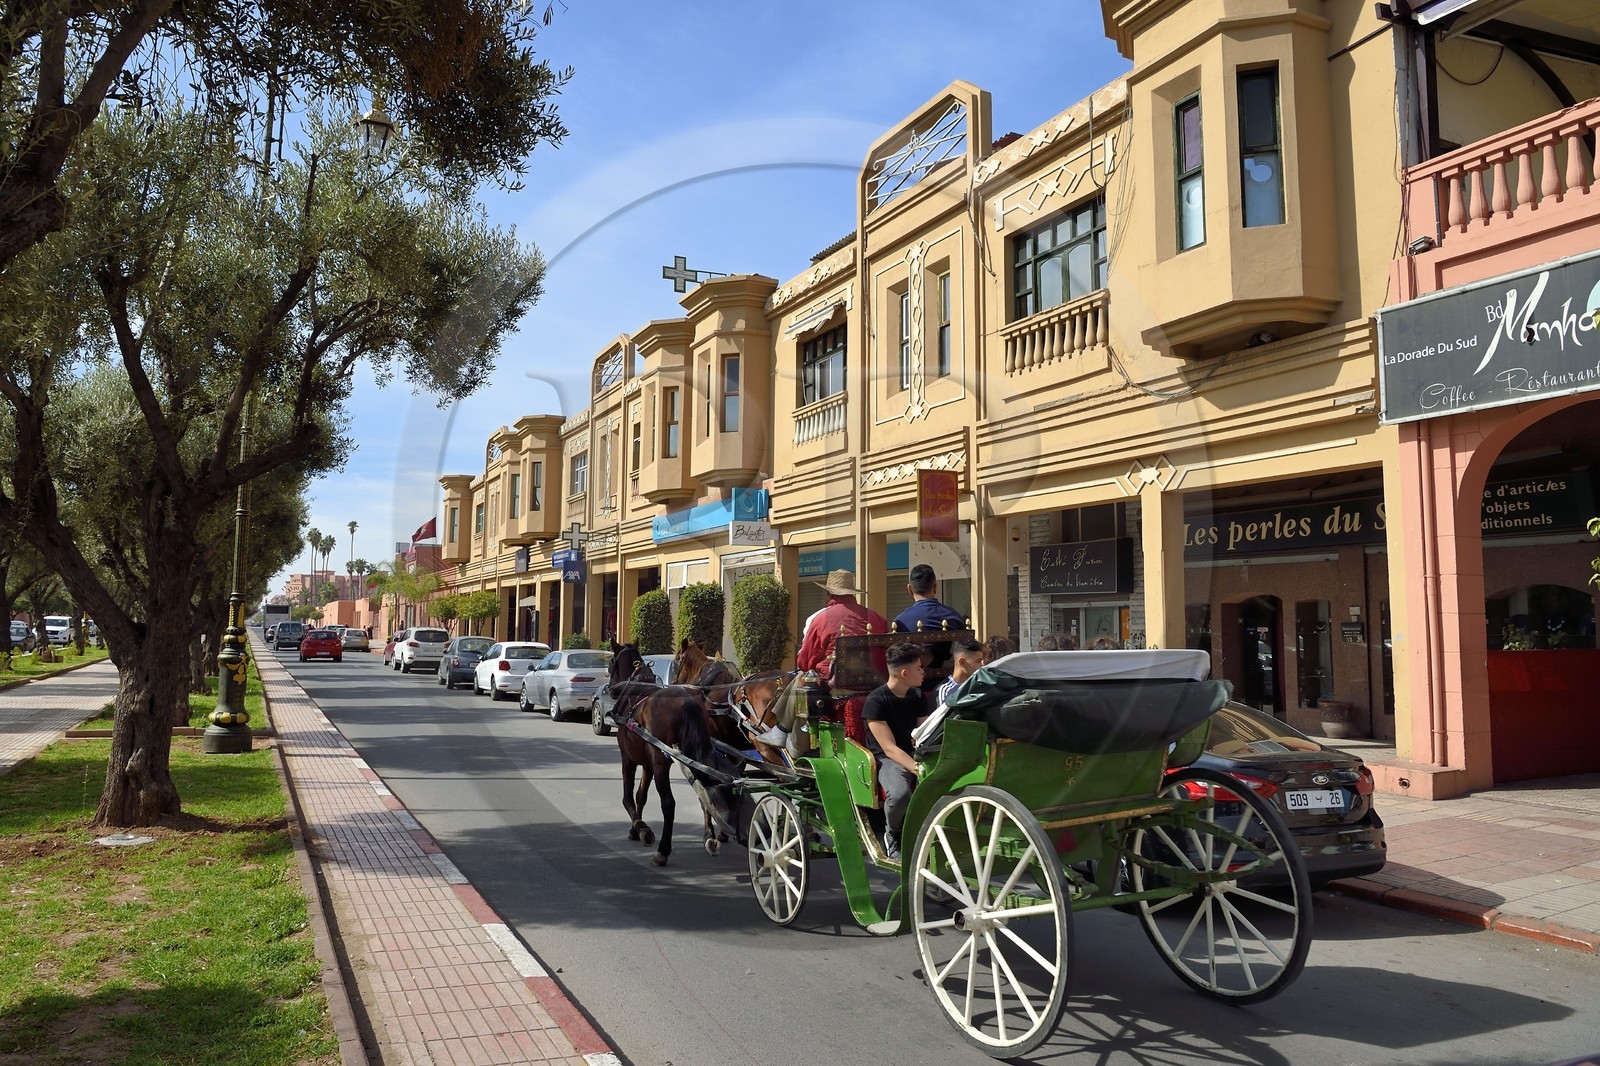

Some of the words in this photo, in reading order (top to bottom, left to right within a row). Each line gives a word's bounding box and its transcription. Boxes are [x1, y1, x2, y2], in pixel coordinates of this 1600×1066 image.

[1485, 299, 1504, 323] Bd
[1384, 354, 1396, 366] La
[1397, 345, 1435, 363] Dorade
[1437, 342, 1454, 354] Du
[1456, 335, 1478, 350] Sud
[1419, 383, 1476, 409] Coffee
[1184, 523, 1219, 547] Les
[1227, 512, 1312, 550] perles
[1323, 506, 1362, 535] du
[563, 571, 581, 580] AXA
[1064, 756, 1084, 771] 95
[1289, 793, 1309, 807] 509
[1329, 792, 1341, 805] 26
